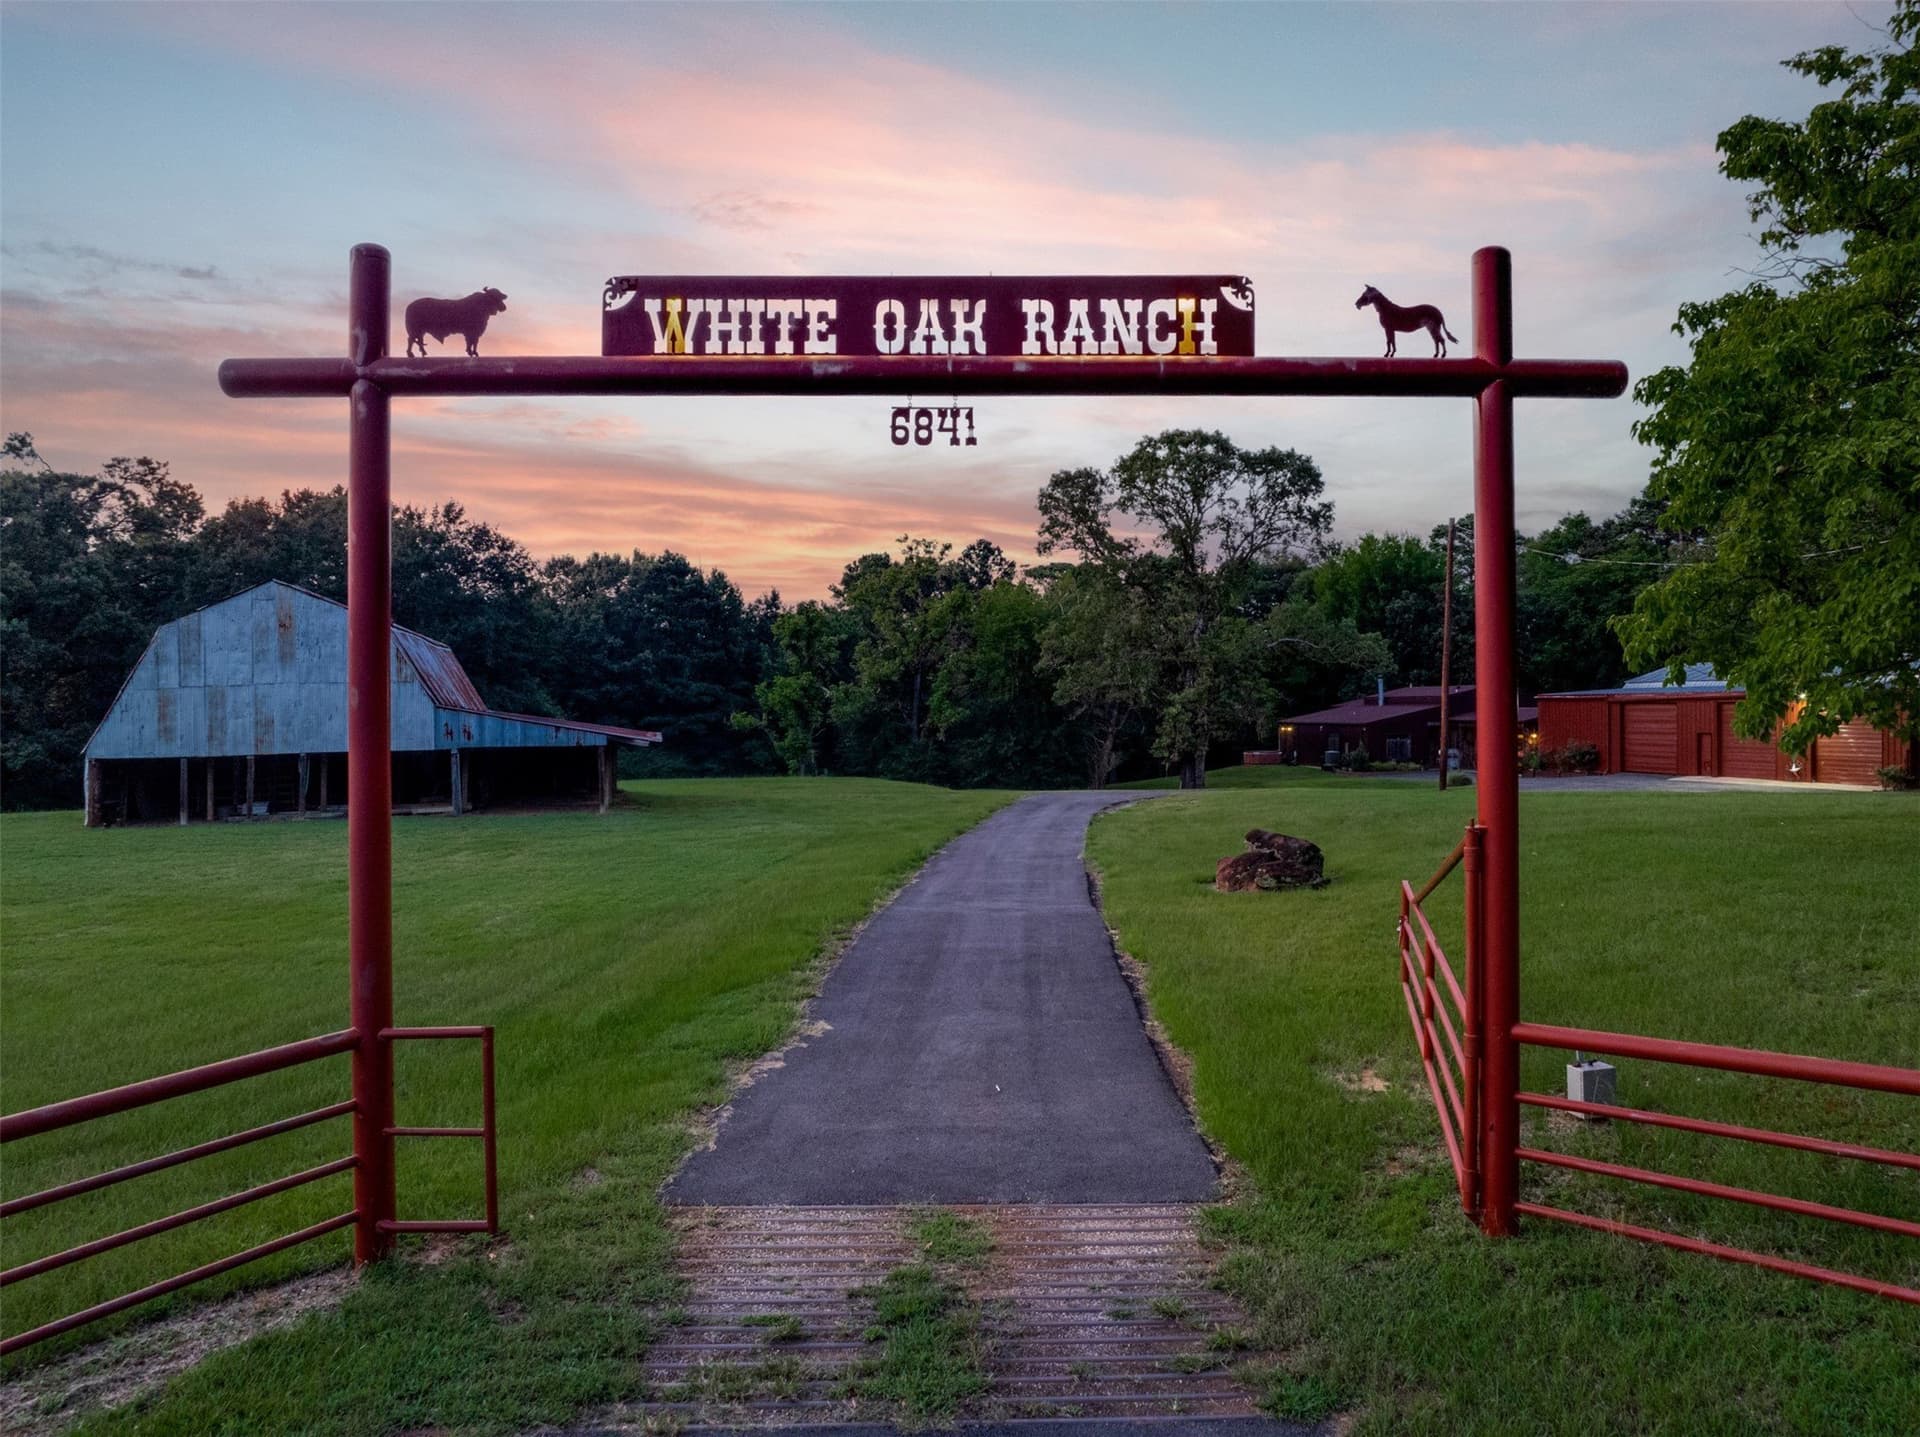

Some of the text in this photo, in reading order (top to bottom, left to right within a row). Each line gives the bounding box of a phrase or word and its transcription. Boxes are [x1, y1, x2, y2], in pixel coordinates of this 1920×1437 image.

[644, 299, 1218, 354] WHITE OAK RANCH
[890, 407, 978, 446] 6841
